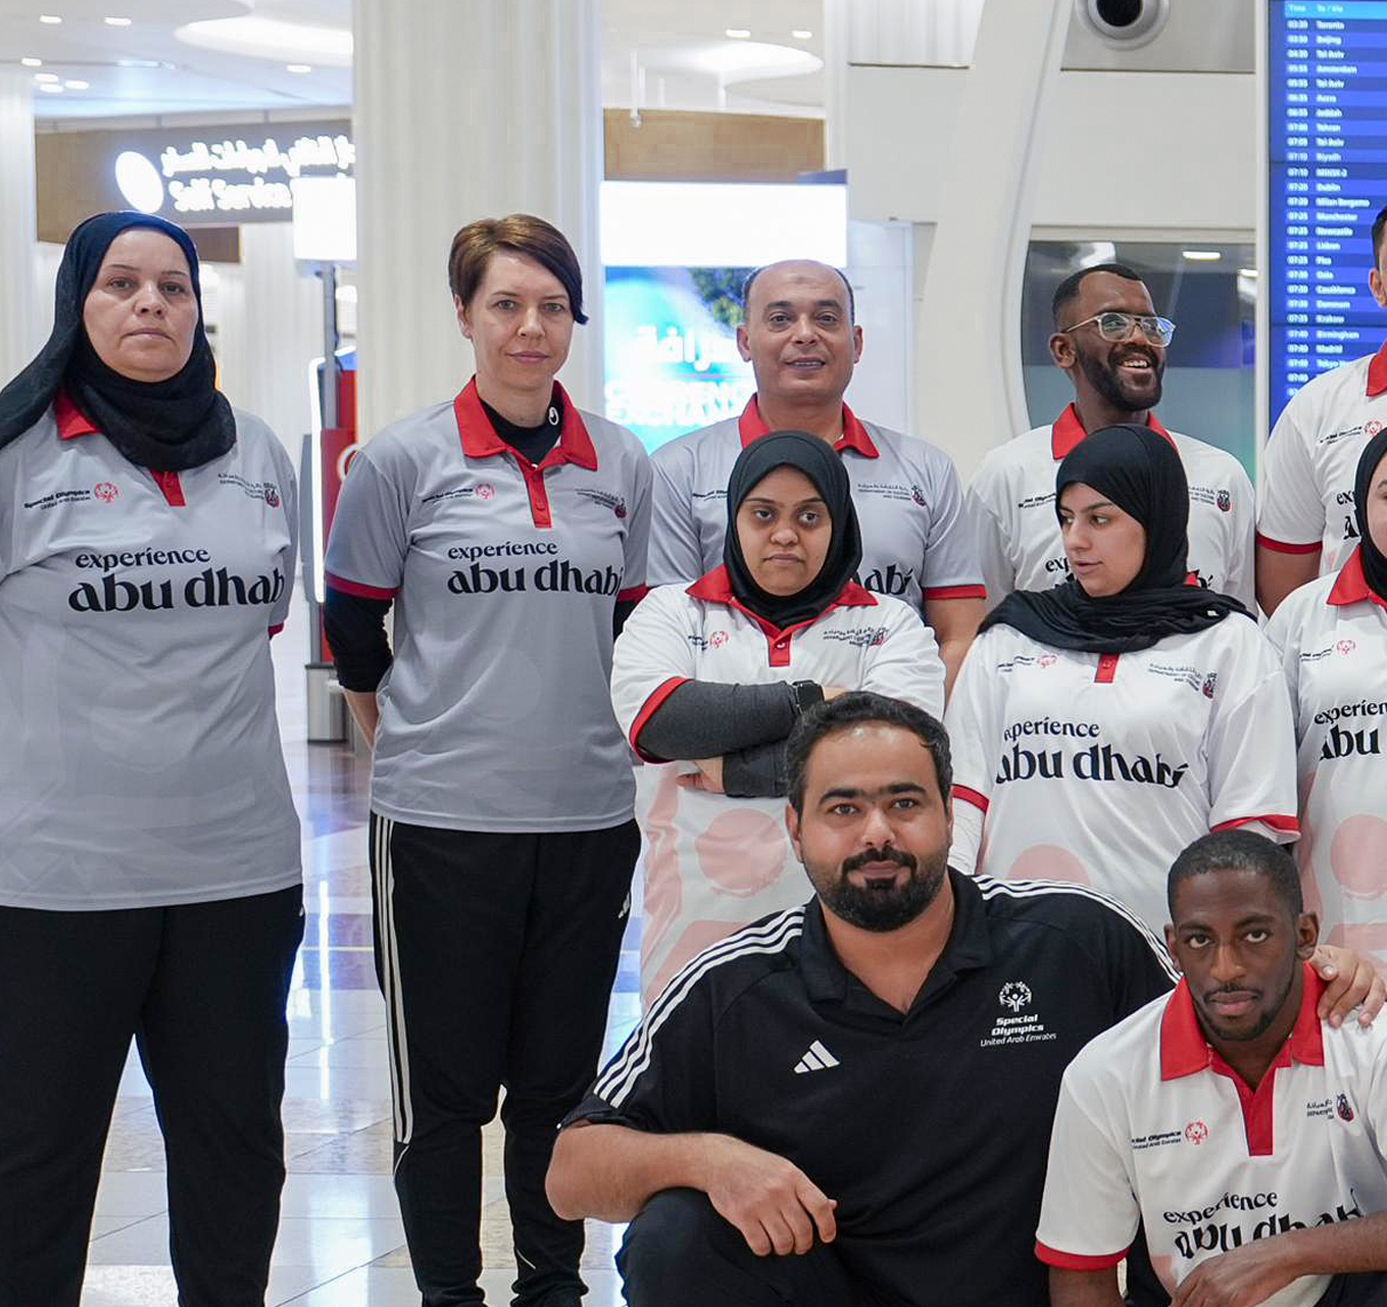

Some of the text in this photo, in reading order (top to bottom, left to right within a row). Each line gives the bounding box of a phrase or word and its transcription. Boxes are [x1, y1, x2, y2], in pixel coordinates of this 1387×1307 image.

[75, 547, 210, 572] experience
[448, 541, 557, 561] experience
[447, 562, 527, 594] abu
[68, 567, 285, 612] abu dhab
[996, 1014, 1038, 1026] Special
[980, 1037, 1006, 1047] United
[1026, 1033, 1056, 1042] Emirates
[992, 1025, 1044, 1036] Olympics
